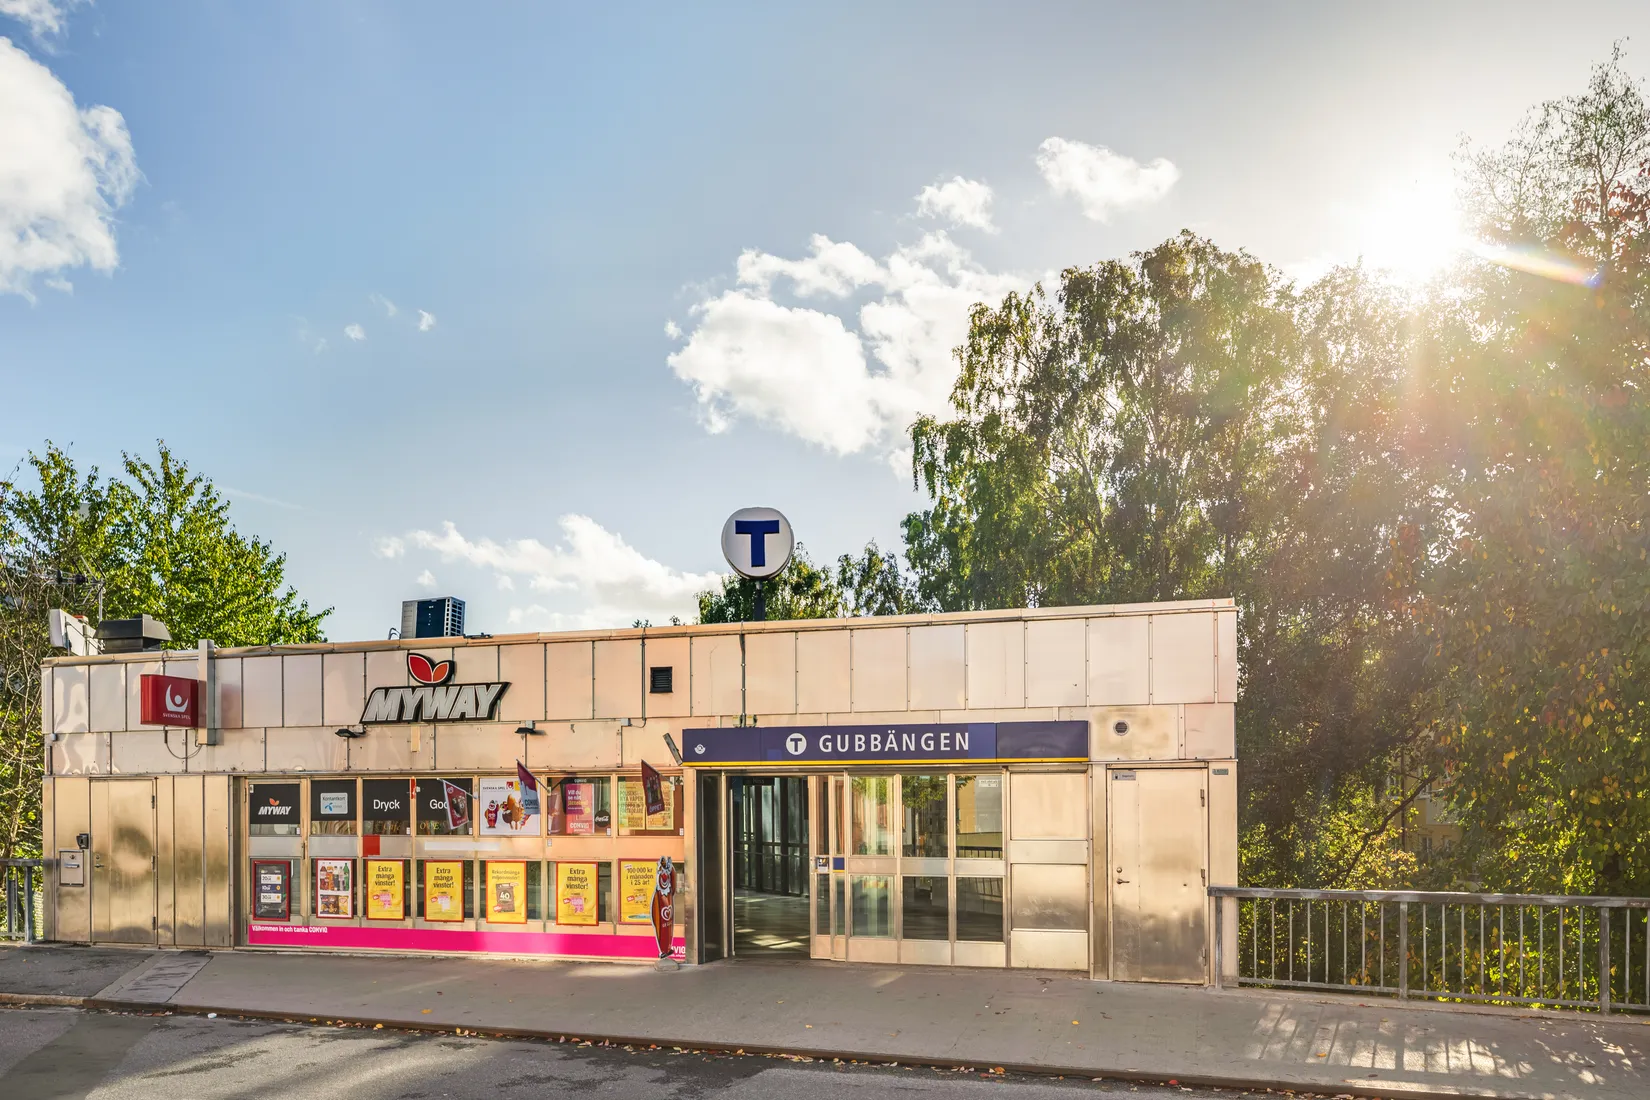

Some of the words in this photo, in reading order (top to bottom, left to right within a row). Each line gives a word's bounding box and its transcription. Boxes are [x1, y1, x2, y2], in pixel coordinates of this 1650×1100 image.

[735, 520, 779, 567] T
[361, 684, 502, 722] MYWAY
[790, 738, 802, 752] T
[819, 730, 969, 753] GUBBÄNGEN
[258, 806, 292, 815] MYWAY
[373, 799, 400, 811] Dryck
[569, 867, 585, 875] Extra
[567, 875, 587, 883] många
